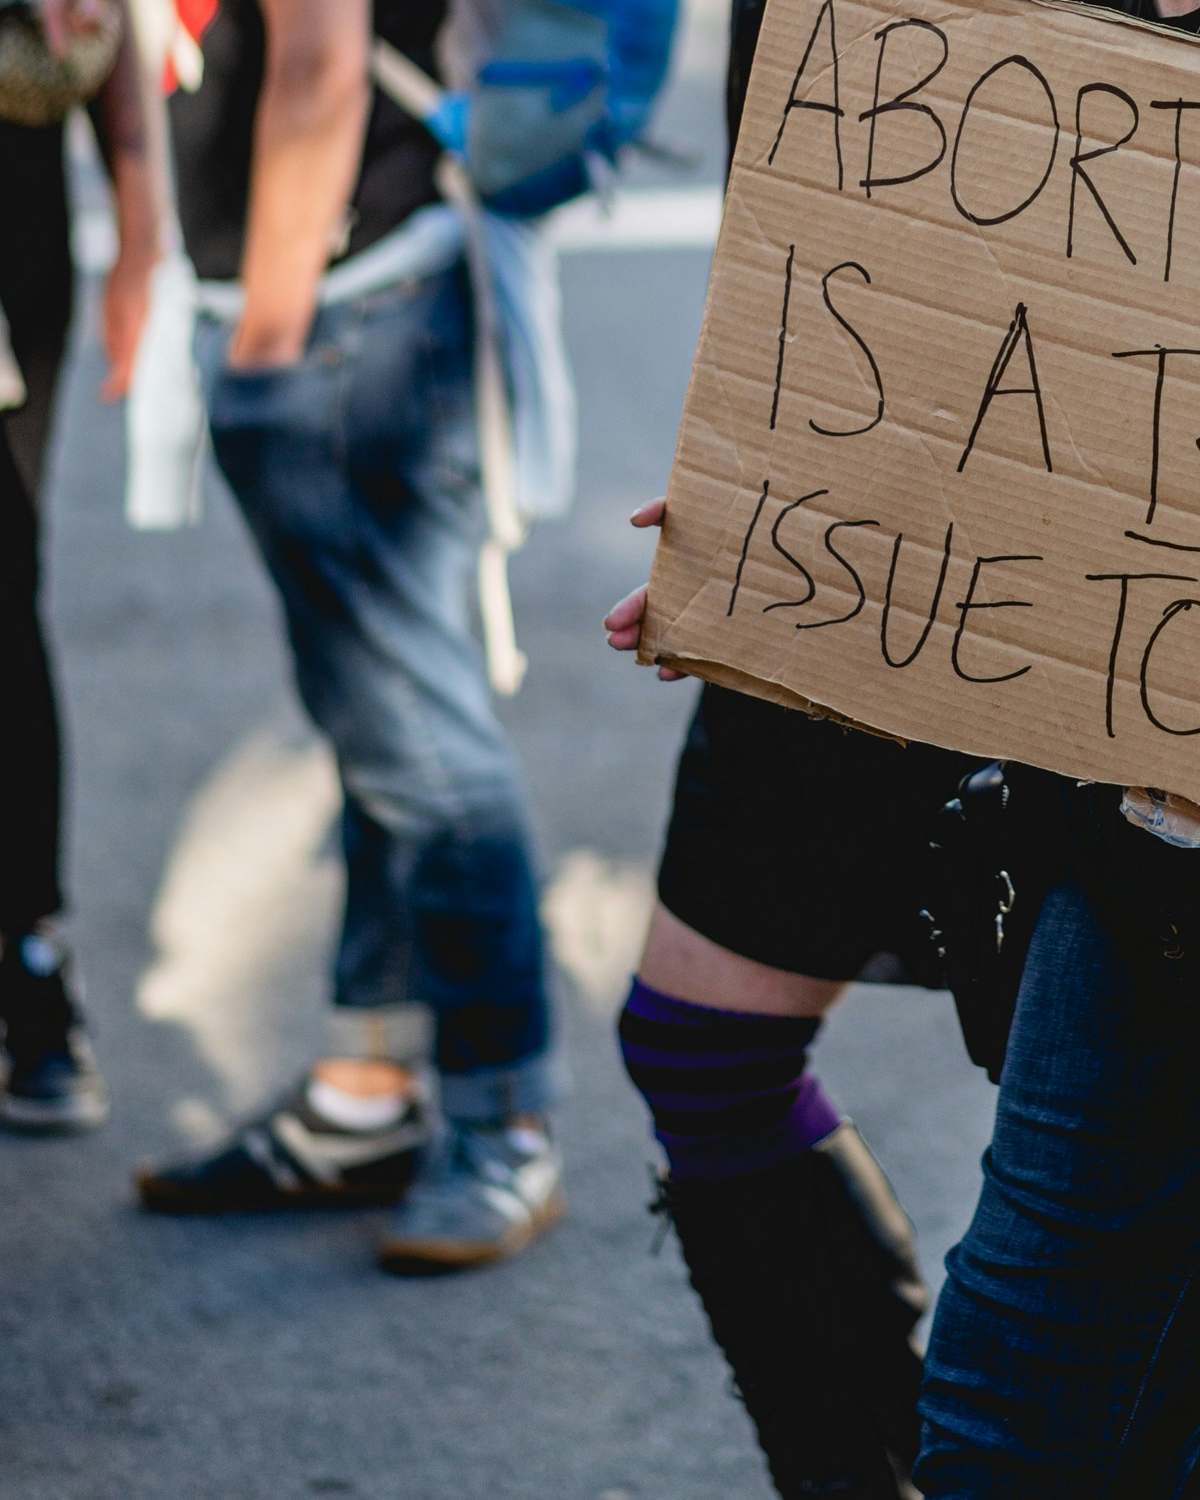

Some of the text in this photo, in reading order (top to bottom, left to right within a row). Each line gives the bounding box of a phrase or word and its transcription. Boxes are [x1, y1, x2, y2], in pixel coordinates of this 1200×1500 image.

[770, 245, 884, 437] IS
[956, 302, 1053, 473] A
[726, 479, 1044, 684] ISSUE
